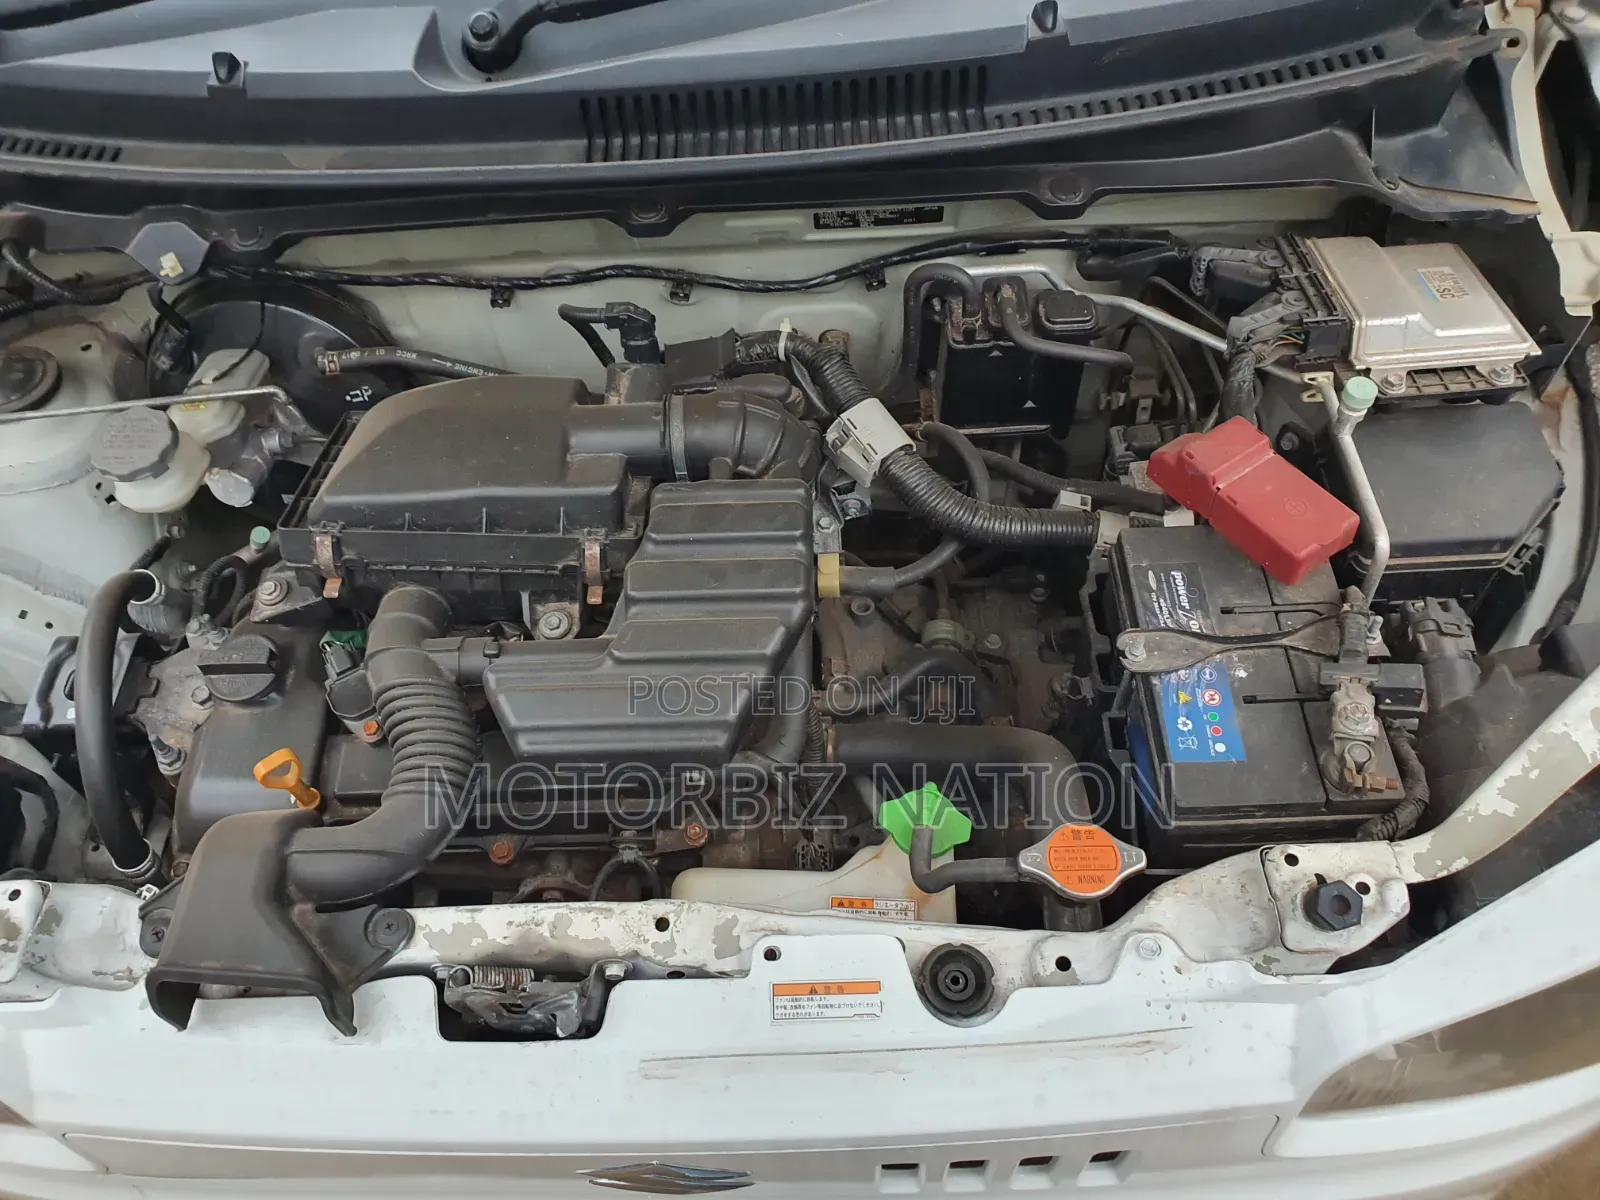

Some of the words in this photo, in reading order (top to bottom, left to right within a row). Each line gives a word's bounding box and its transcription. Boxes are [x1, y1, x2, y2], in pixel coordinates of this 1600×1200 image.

[1071, 829, 1096, 841] 警告
[1077, 874, 1106, 885] WARNING
[823, 985, 845, 994] 警告
